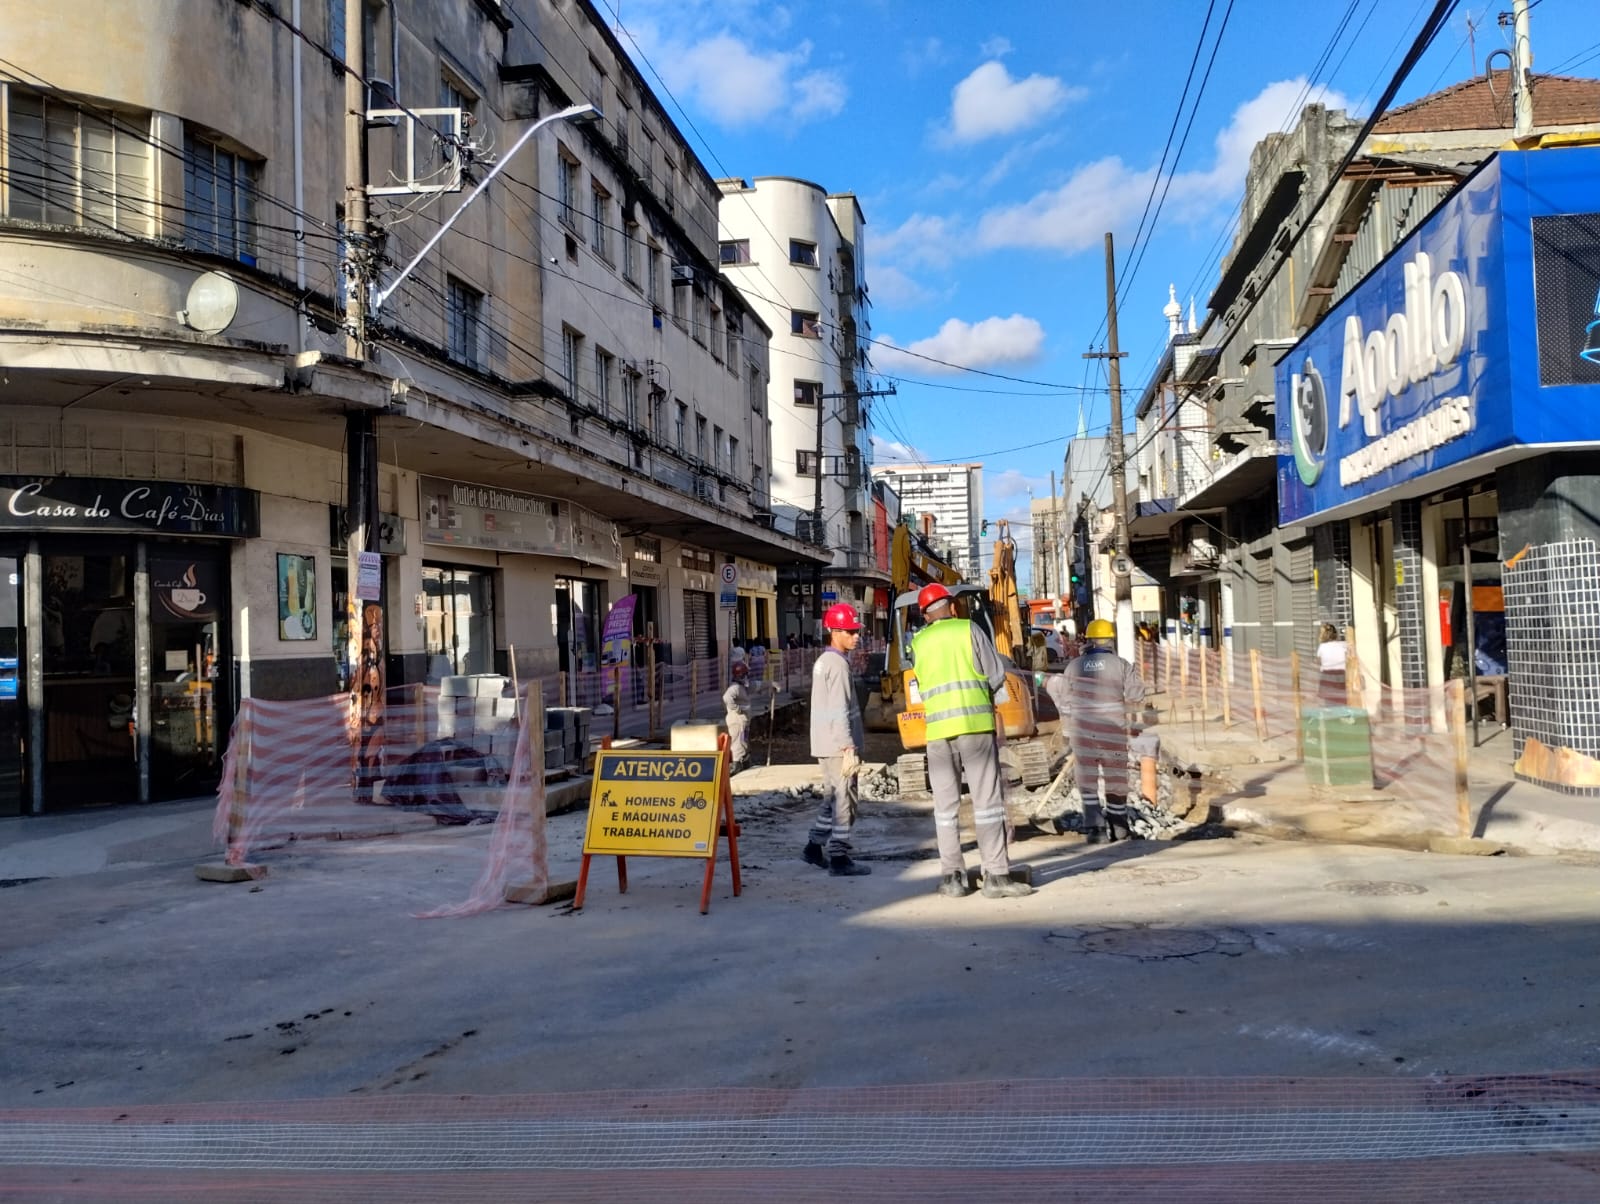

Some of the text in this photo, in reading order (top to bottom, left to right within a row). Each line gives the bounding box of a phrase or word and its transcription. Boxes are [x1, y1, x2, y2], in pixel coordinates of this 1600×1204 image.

[1338, 252, 1466, 436] Apollo
[8, 482, 225, 525] Casa do Café Dias
[452, 484, 477, 507] Outlet
[478, 489, 489, 508] de
[726, 568, 732, 579] E
[613, 758, 702, 780] ATENÇÃO
[625, 796, 676, 807] HOMENS
[611, 810, 686, 822] E MÁQUINAS
[602, 827, 692, 839] TRABALHANDO
